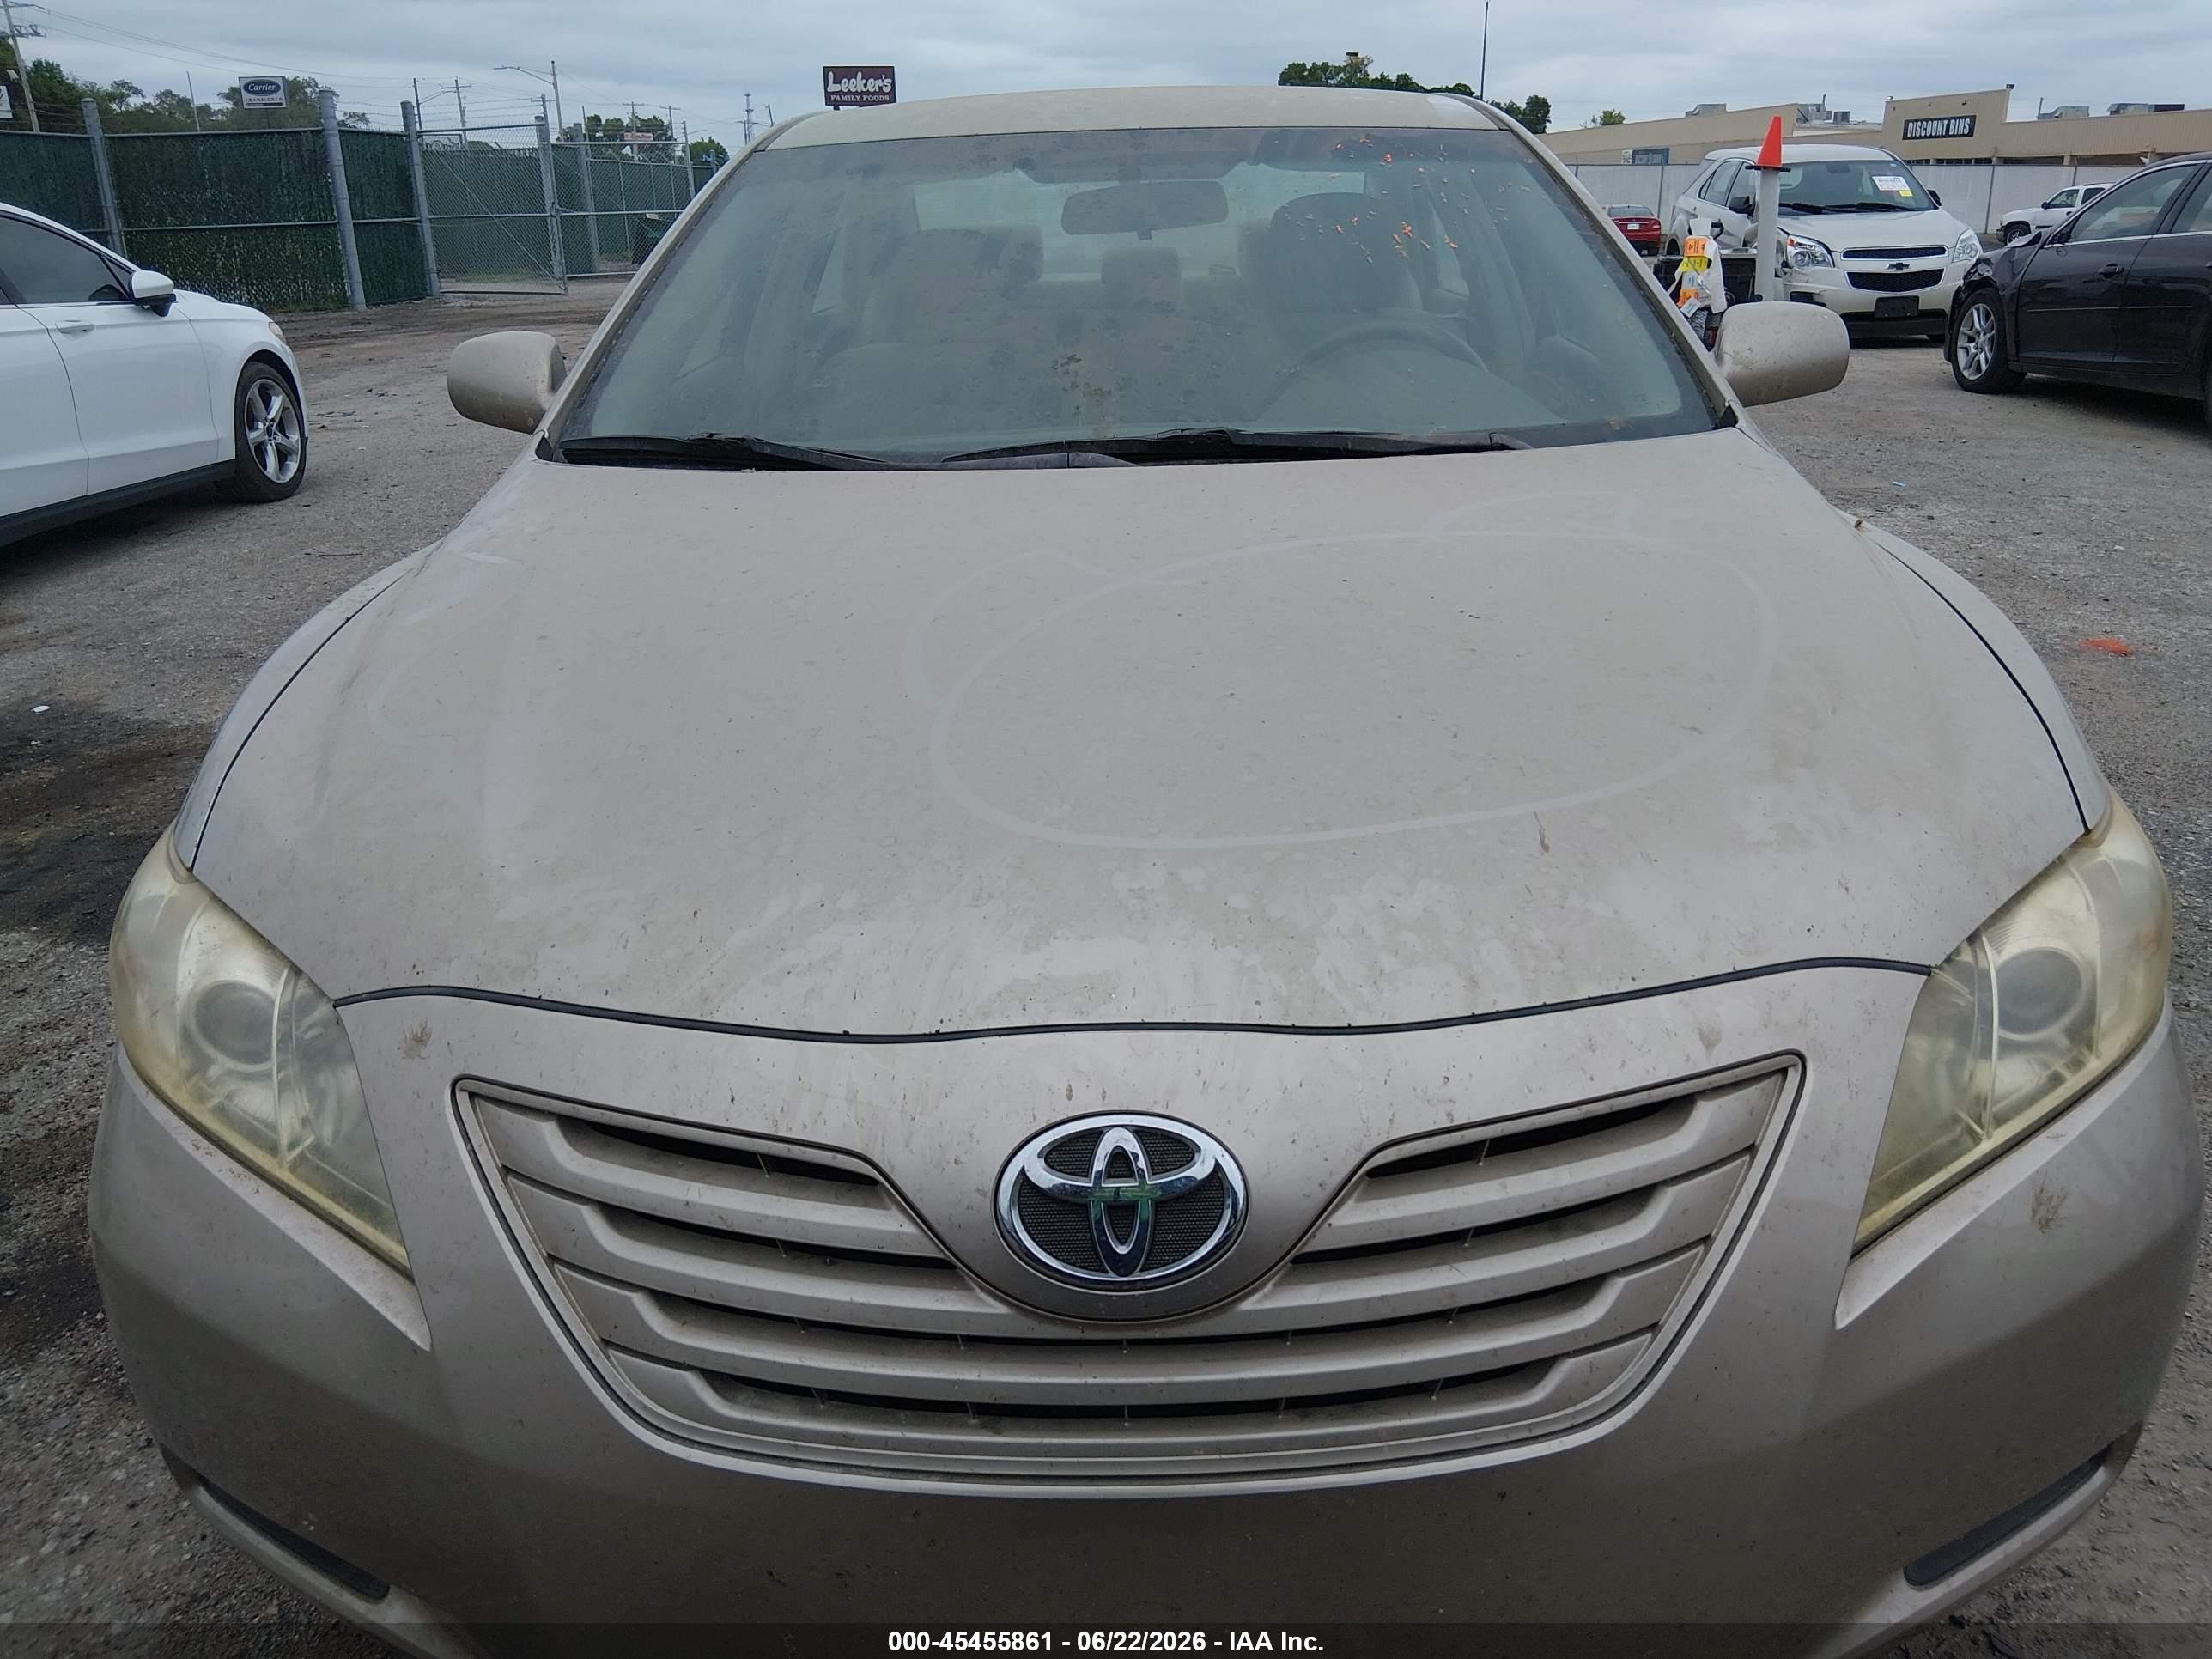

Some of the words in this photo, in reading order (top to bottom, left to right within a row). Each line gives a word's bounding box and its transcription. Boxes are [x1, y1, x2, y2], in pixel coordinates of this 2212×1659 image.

[827, 71, 892, 93] Leeker's
[1907, 119, 1948, 137] DISCOUNT
[1948, 118, 1971, 135] BINS
